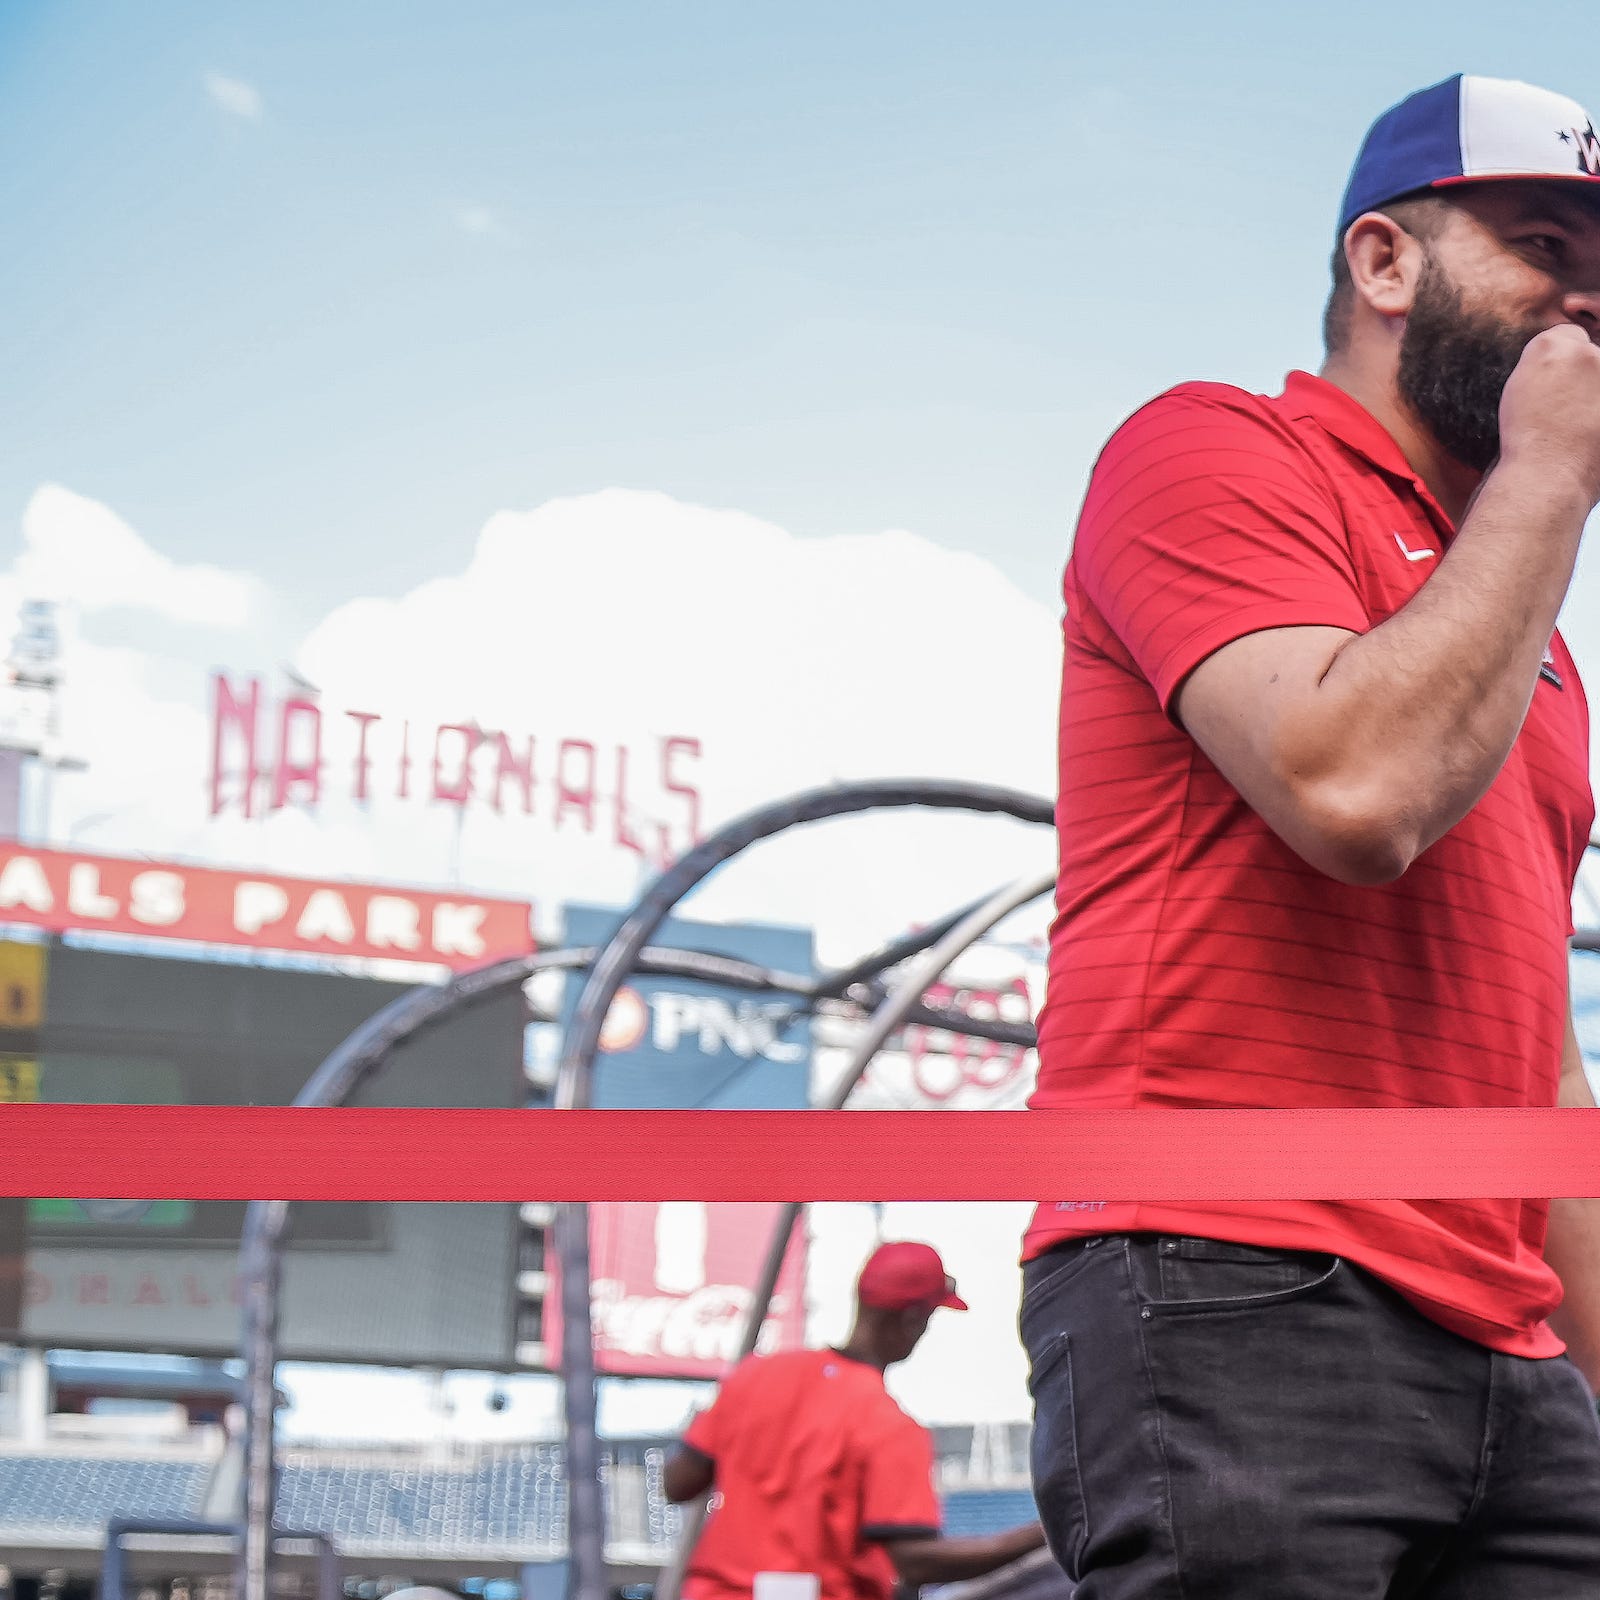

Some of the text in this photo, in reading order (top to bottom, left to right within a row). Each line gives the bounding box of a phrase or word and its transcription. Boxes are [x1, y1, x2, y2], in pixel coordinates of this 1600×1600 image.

[209, 672, 702, 870] NATIONALS
[232, 880, 488, 958] PARK
[649, 991, 806, 1064] PNC
